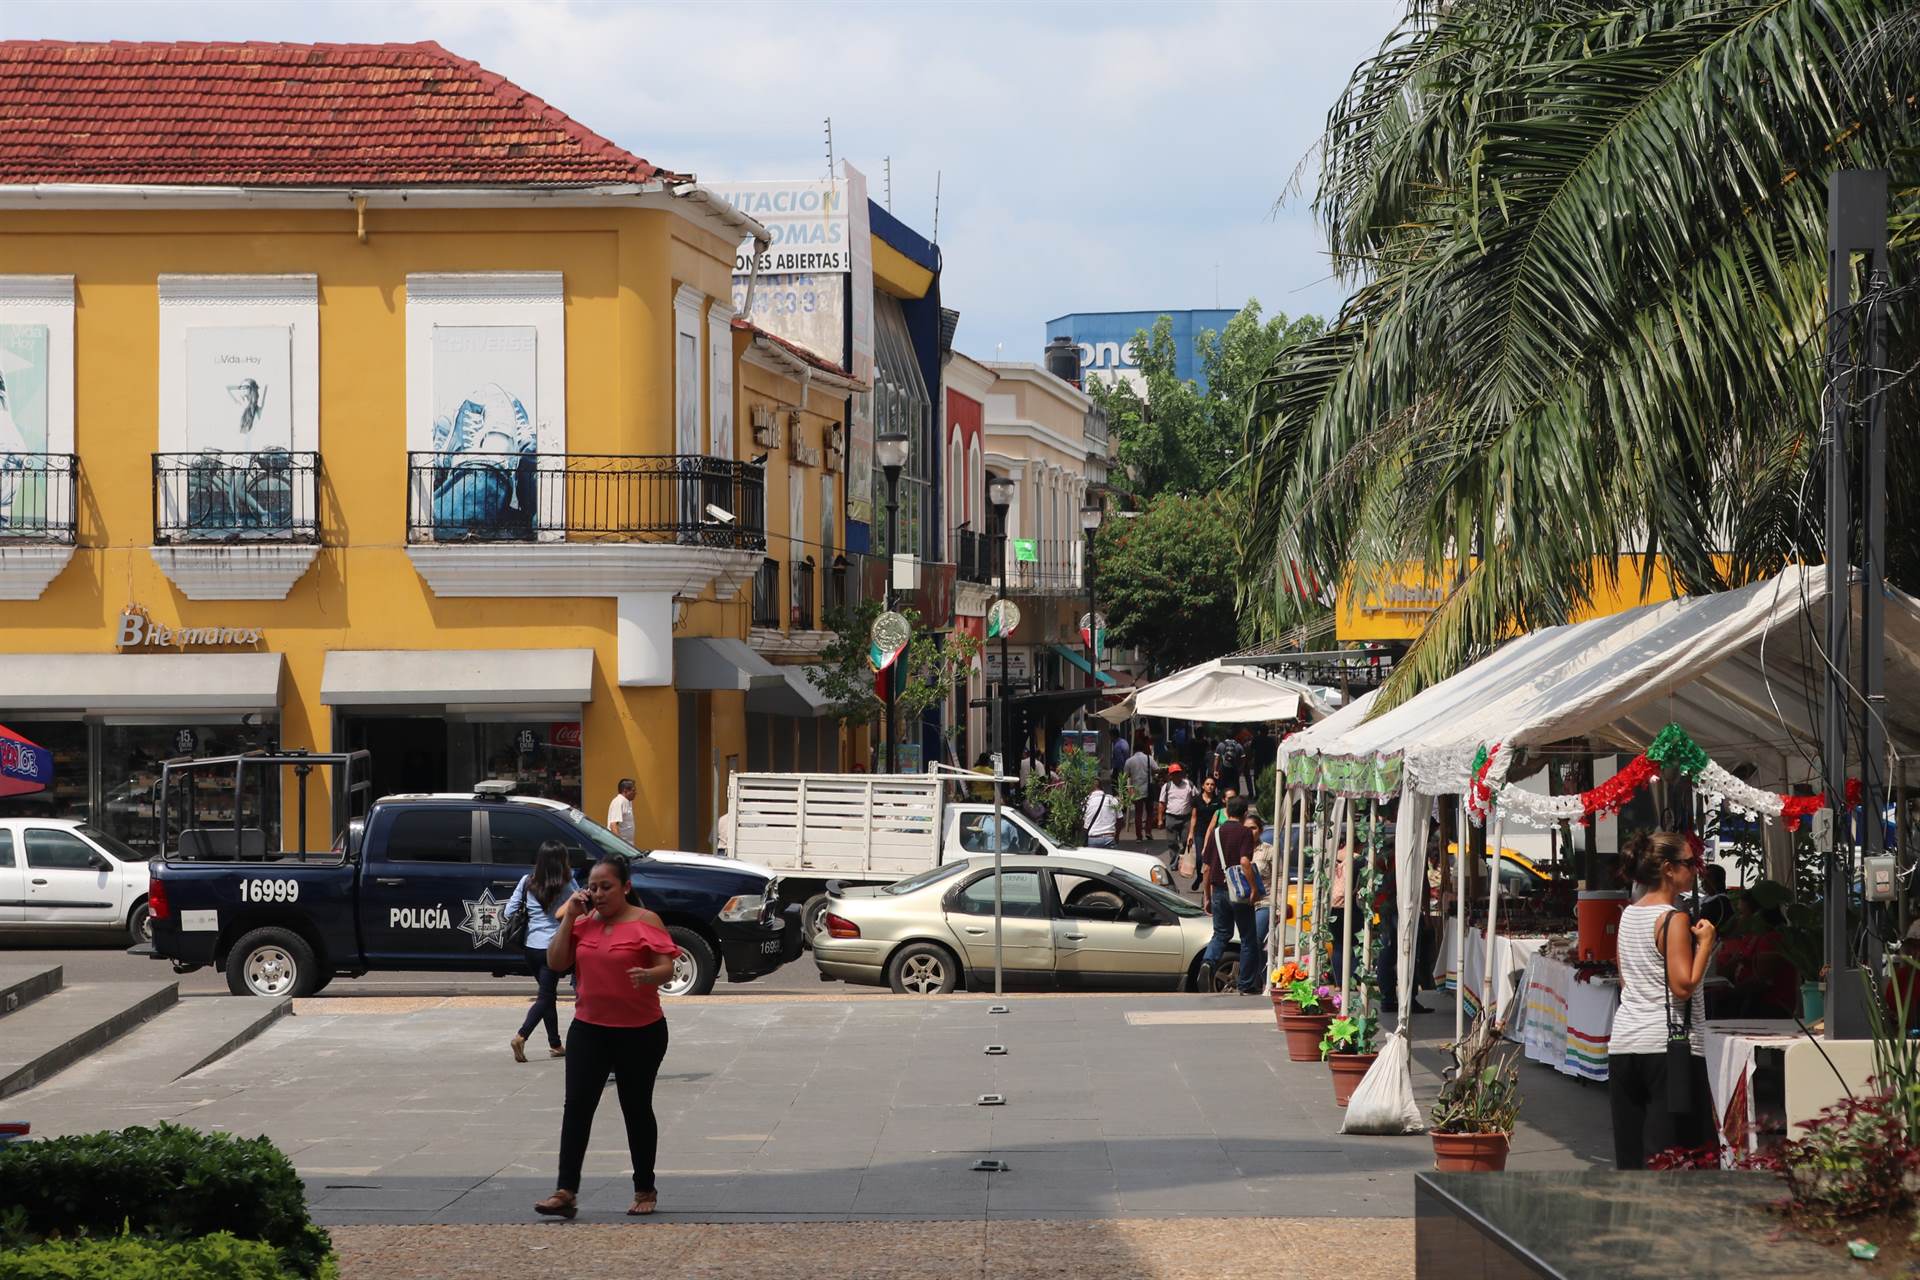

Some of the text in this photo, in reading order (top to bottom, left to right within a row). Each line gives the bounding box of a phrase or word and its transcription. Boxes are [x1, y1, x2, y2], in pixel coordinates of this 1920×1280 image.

[776, 253, 840, 269] ABIERTAS
[221, 354, 240, 364] Vida
[246, 355, 262, 366] Hoy
[240, 878, 299, 903] 16999
[390, 903, 451, 930] POLICÍA
